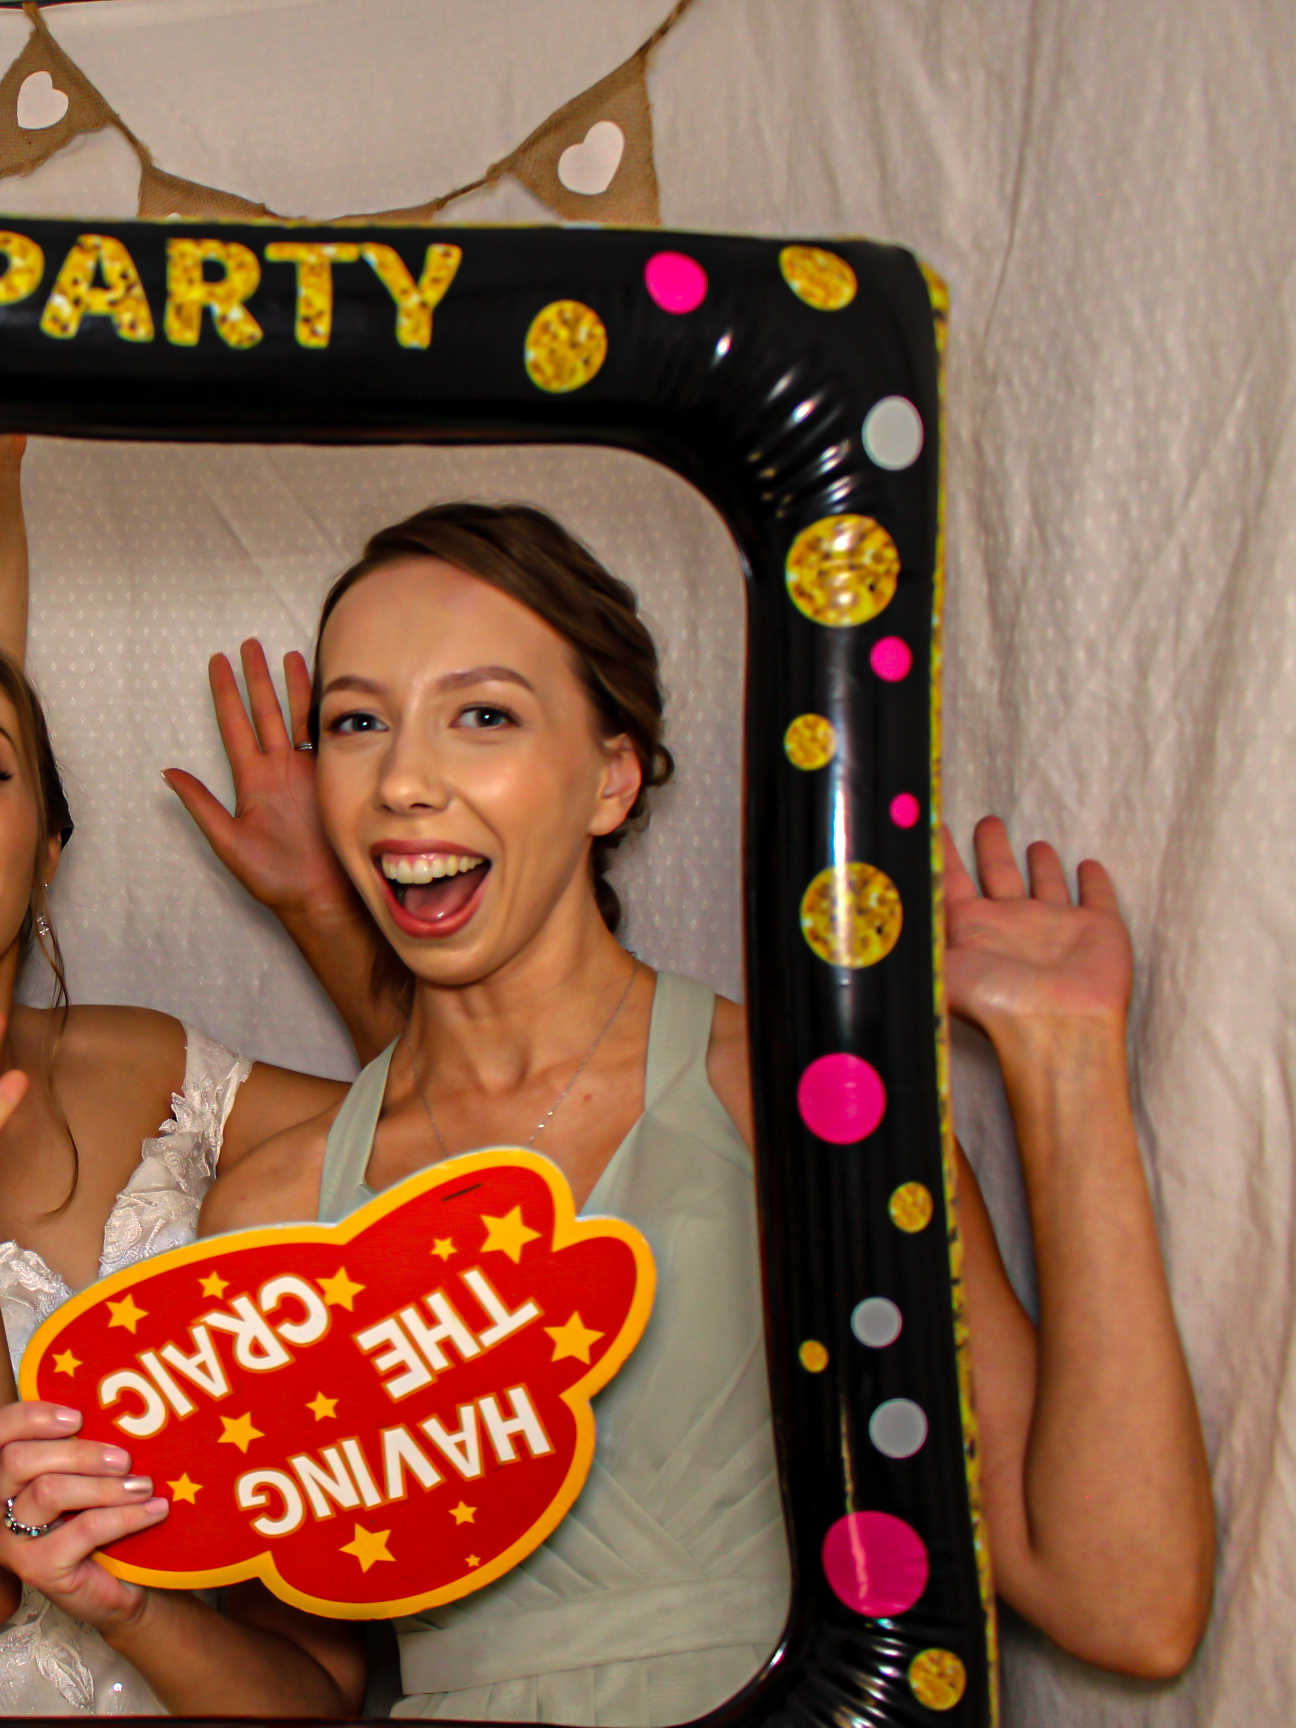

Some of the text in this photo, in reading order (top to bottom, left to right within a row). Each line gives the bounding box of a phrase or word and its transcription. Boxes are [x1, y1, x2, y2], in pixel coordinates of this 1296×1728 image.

[99, 1275, 329, 1438] CRAIC
[355, 1269, 541, 1400] THE
[236, 1386, 552, 1537] HAVING
